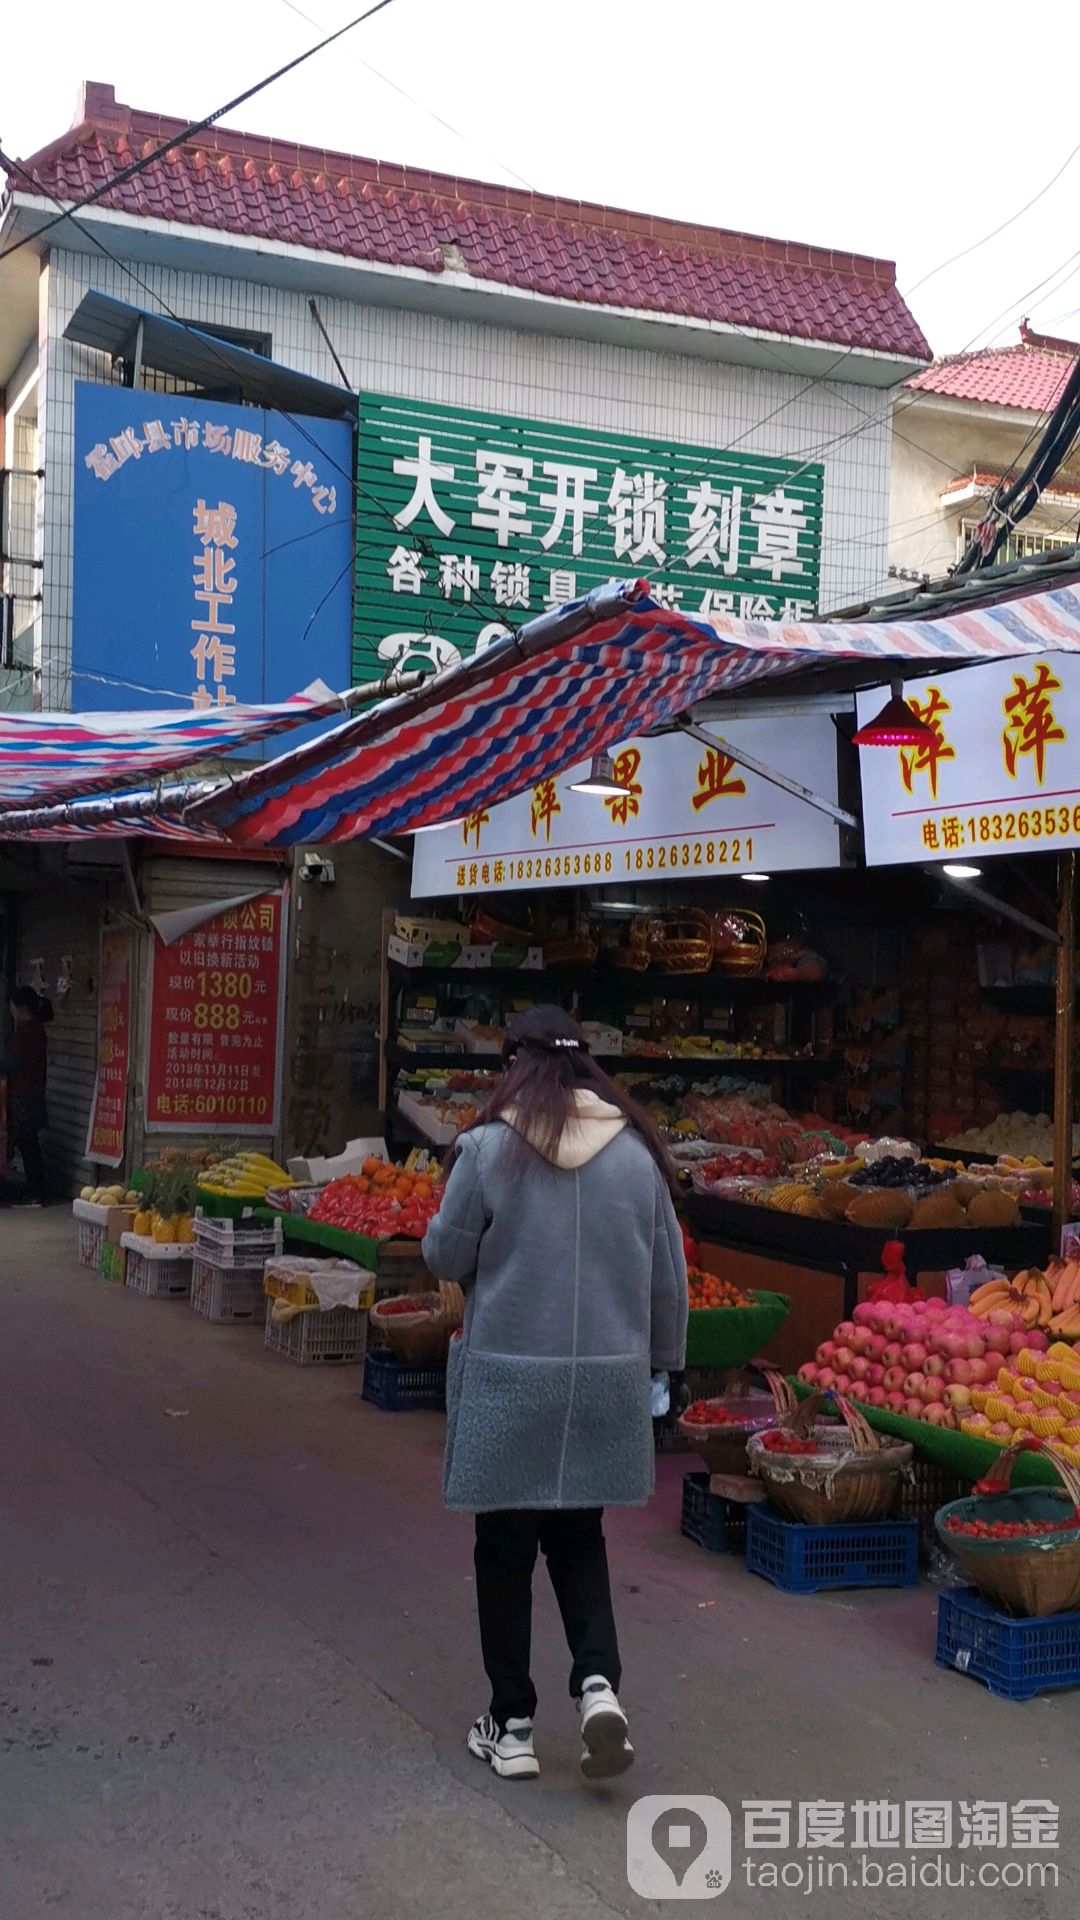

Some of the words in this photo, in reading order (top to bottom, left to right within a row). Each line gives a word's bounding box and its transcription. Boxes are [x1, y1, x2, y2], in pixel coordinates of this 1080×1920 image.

[392, 436, 807, 581] 大军开锁刻章
[456, 851, 613, 887] 送货电话:18326353688
[625, 837, 753, 872] 18326328221
[179, 950, 260, 970] 以旧换新活动
[156, 1093, 267, 1116] 电话:6010110
